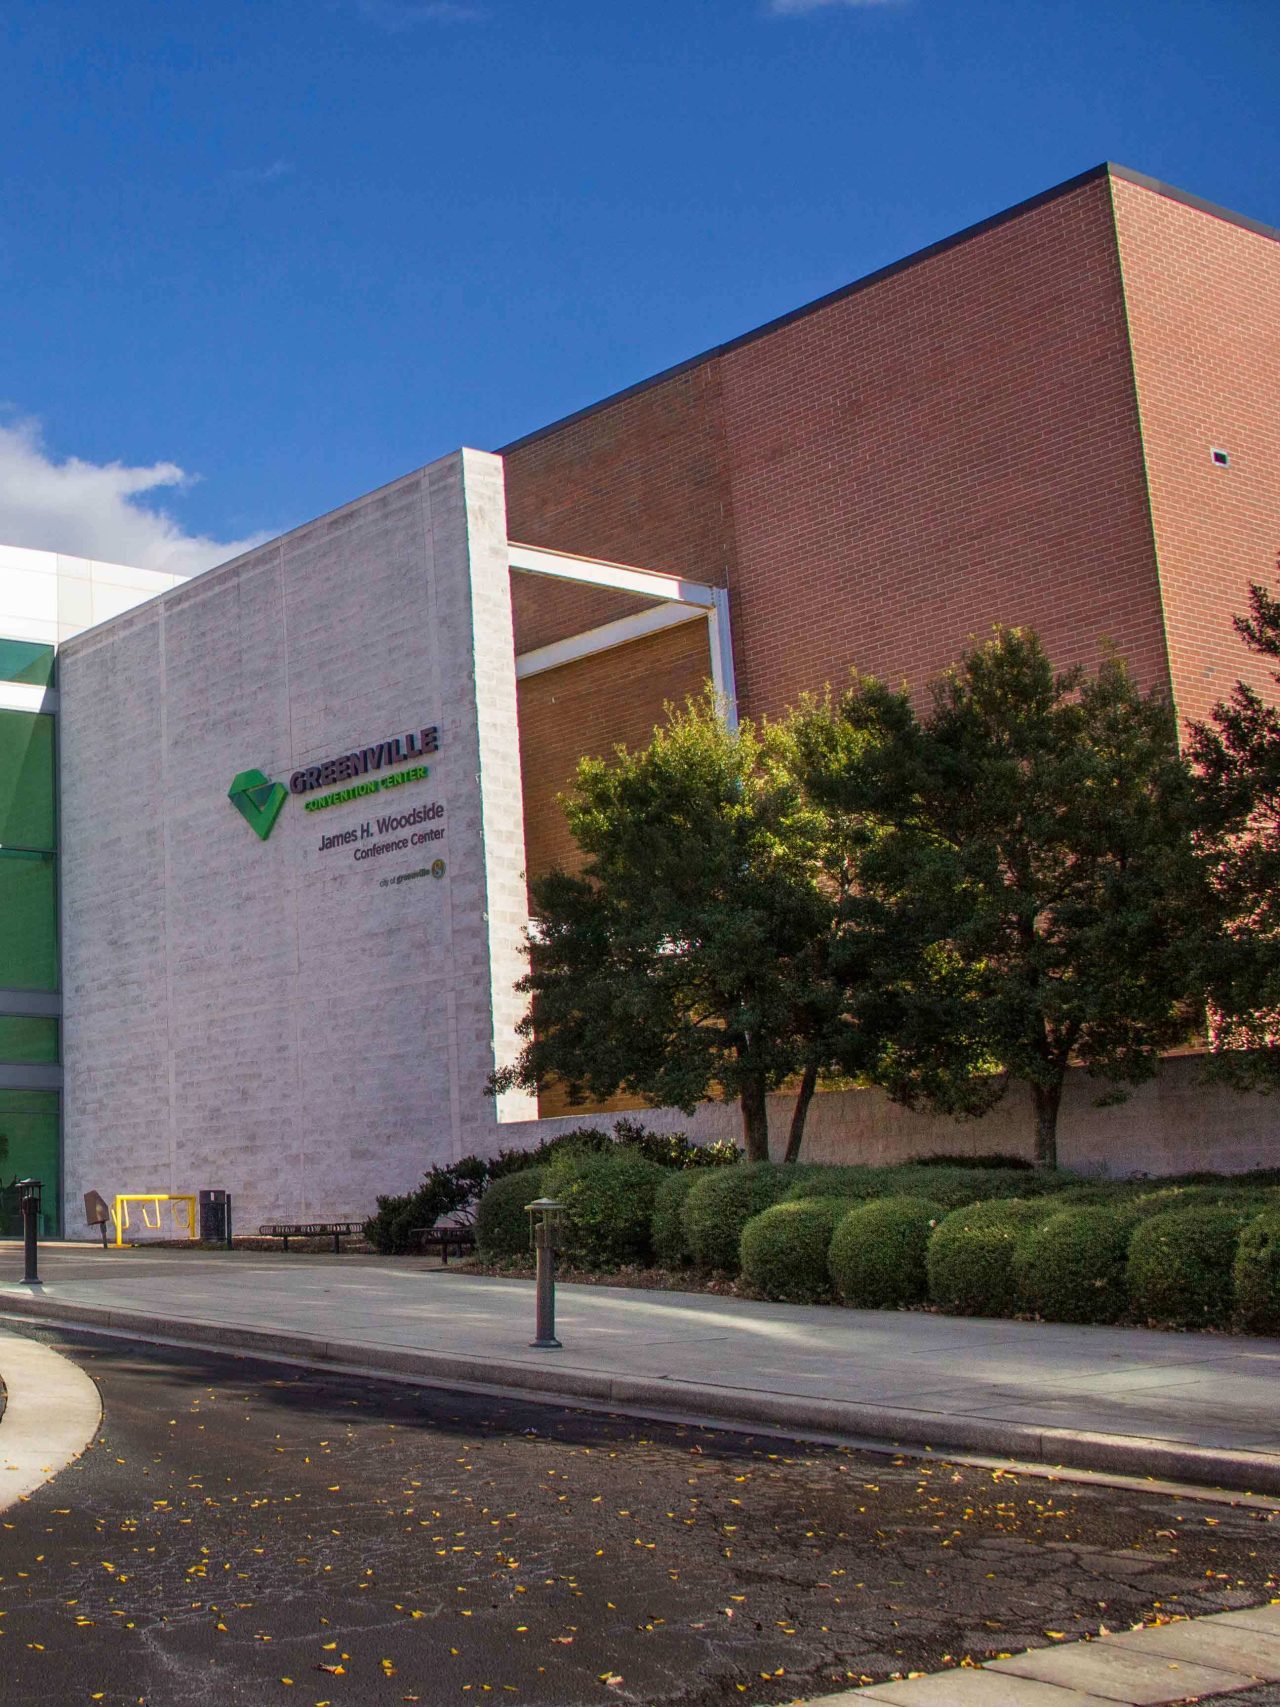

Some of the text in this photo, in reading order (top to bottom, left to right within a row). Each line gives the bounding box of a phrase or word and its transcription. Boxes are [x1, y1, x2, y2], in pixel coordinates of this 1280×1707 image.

[290, 726, 438, 794] GREENVILLE
[304, 766, 428, 812] CONVENTION CENTER
[318, 802, 445, 851] James H. Woodside
[354, 823, 445, 861] Conference Center
